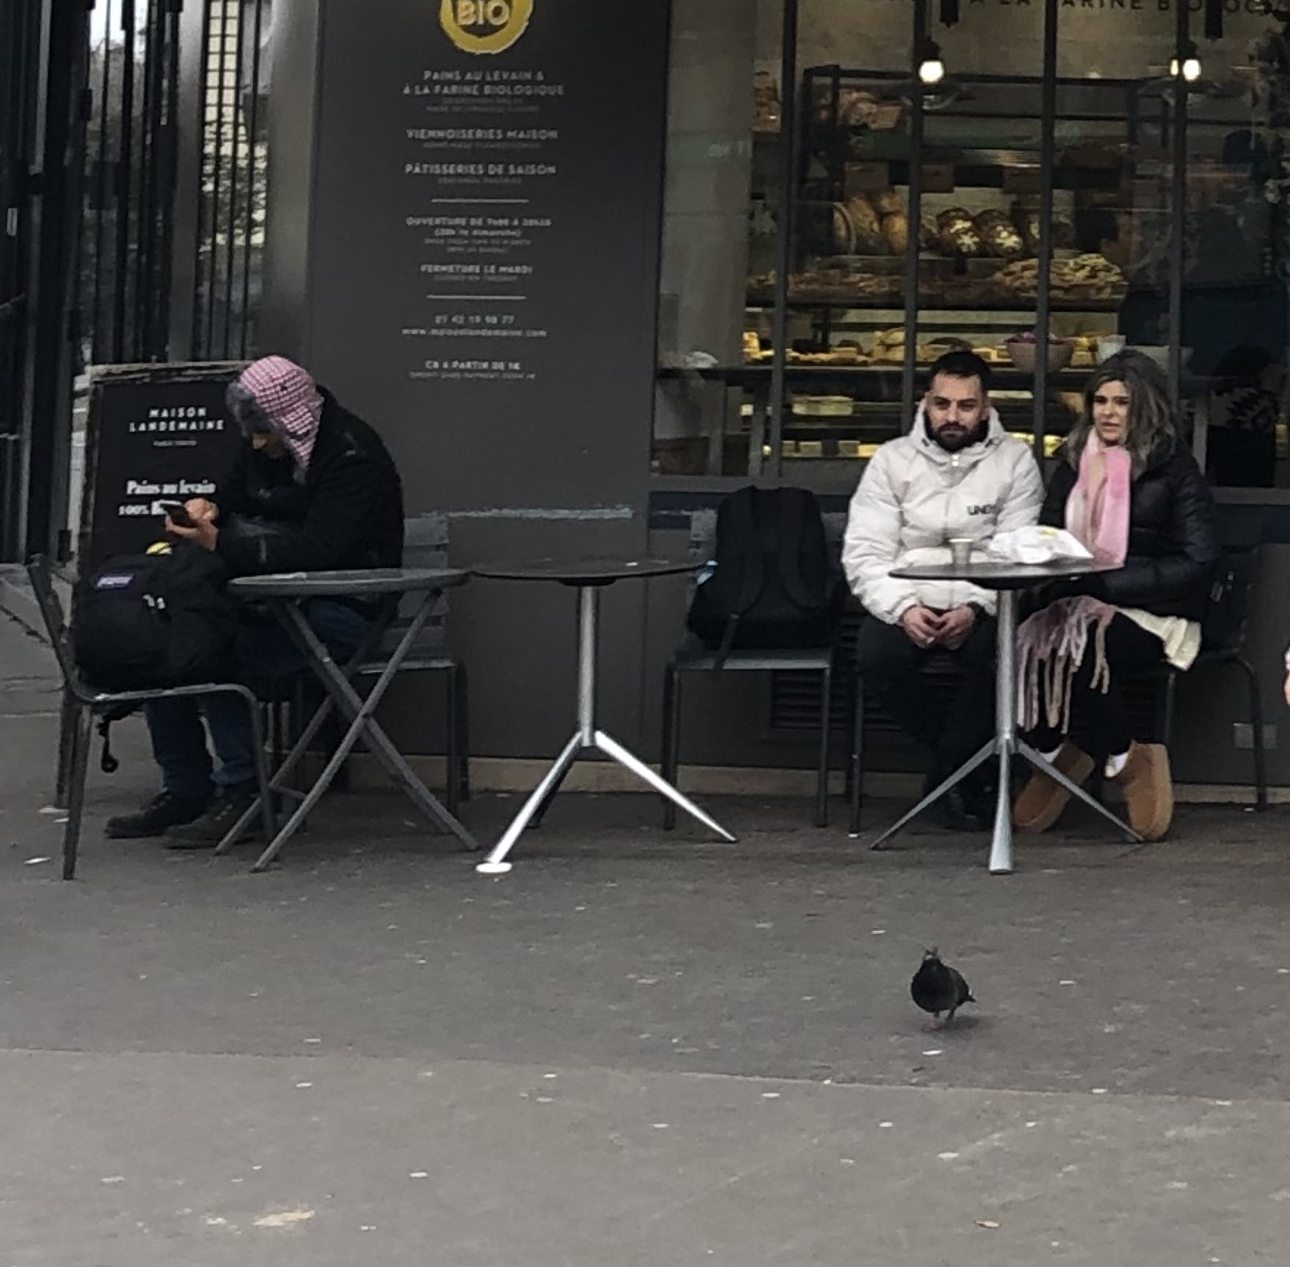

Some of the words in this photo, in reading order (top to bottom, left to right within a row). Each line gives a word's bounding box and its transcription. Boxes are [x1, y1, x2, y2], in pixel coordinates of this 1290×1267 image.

[423, 70, 461, 81] PAINS
[464, 71, 482, 81] AU
[485, 70, 532, 81] LEVAIN
[414, 85, 431, 95] LA
[433, 84, 480, 96] FARINE
[483, 84, 565, 96] BIOLOGIQUE
[406, 128, 504, 140] VIENNOISERIES
[506, 129, 559, 140] MAISON
[487, 164, 505, 175] DE
[508, 164, 557, 175] SAISON
[148, 406, 207, 418] MAISON
[128, 419, 224, 433] LANDEMAINE
[118, 505, 150, 516] 100%
